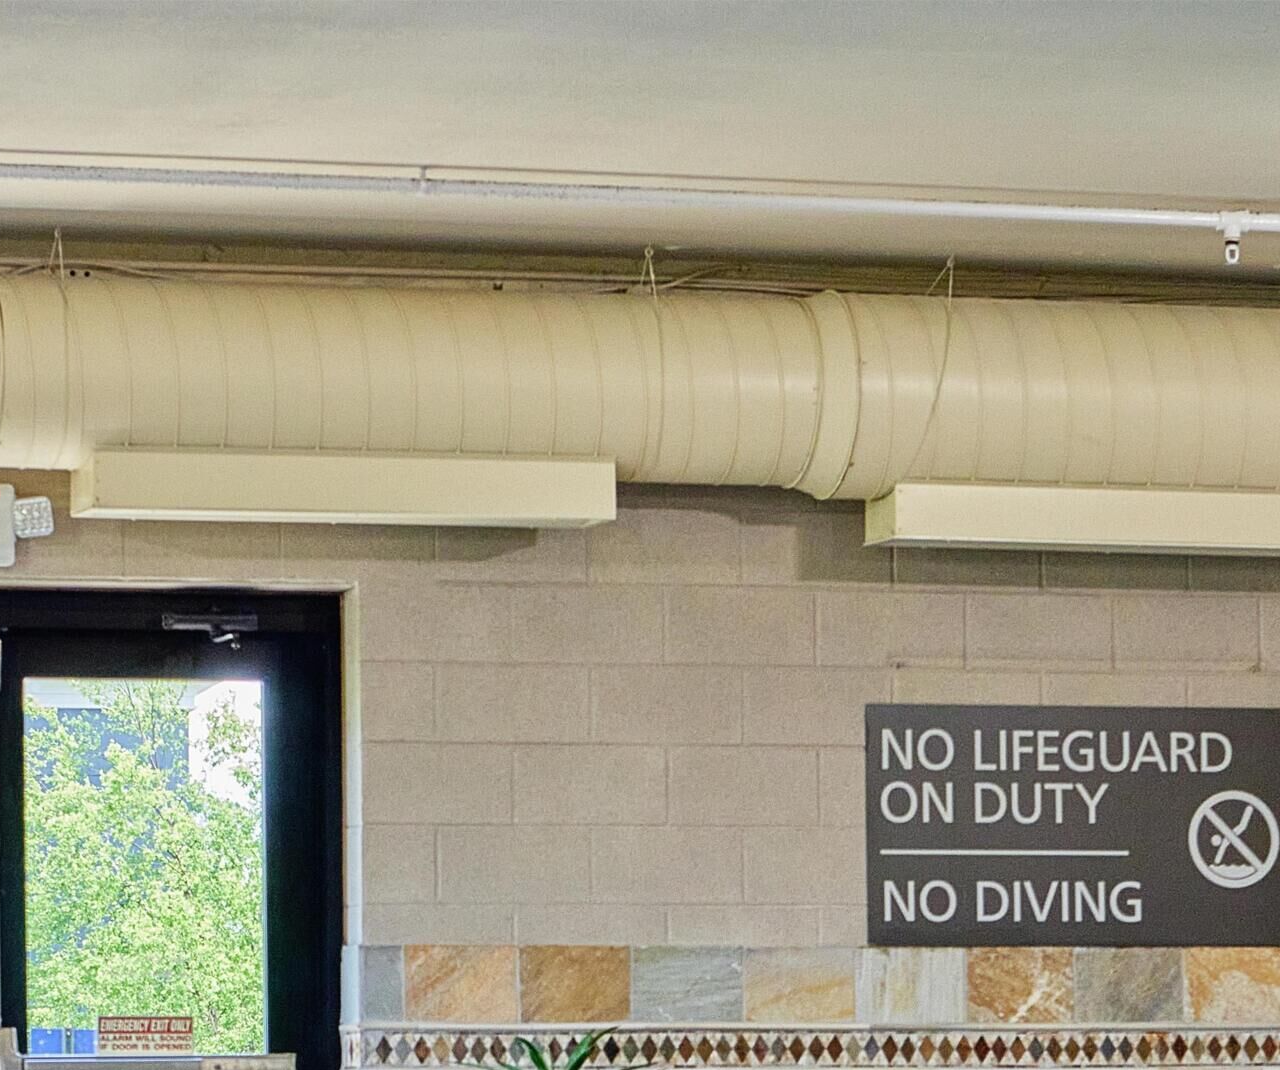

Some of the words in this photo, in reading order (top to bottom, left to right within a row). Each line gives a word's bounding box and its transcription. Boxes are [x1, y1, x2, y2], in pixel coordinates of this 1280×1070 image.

[882, 729, 954, 770] NO
[974, 730, 1232, 772] LIFEGUARD
[881, 781, 953, 823] ON
[975, 782, 1108, 824] DUTY
[884, 880, 956, 922] NO
[977, 881, 1141, 922] DIVING
